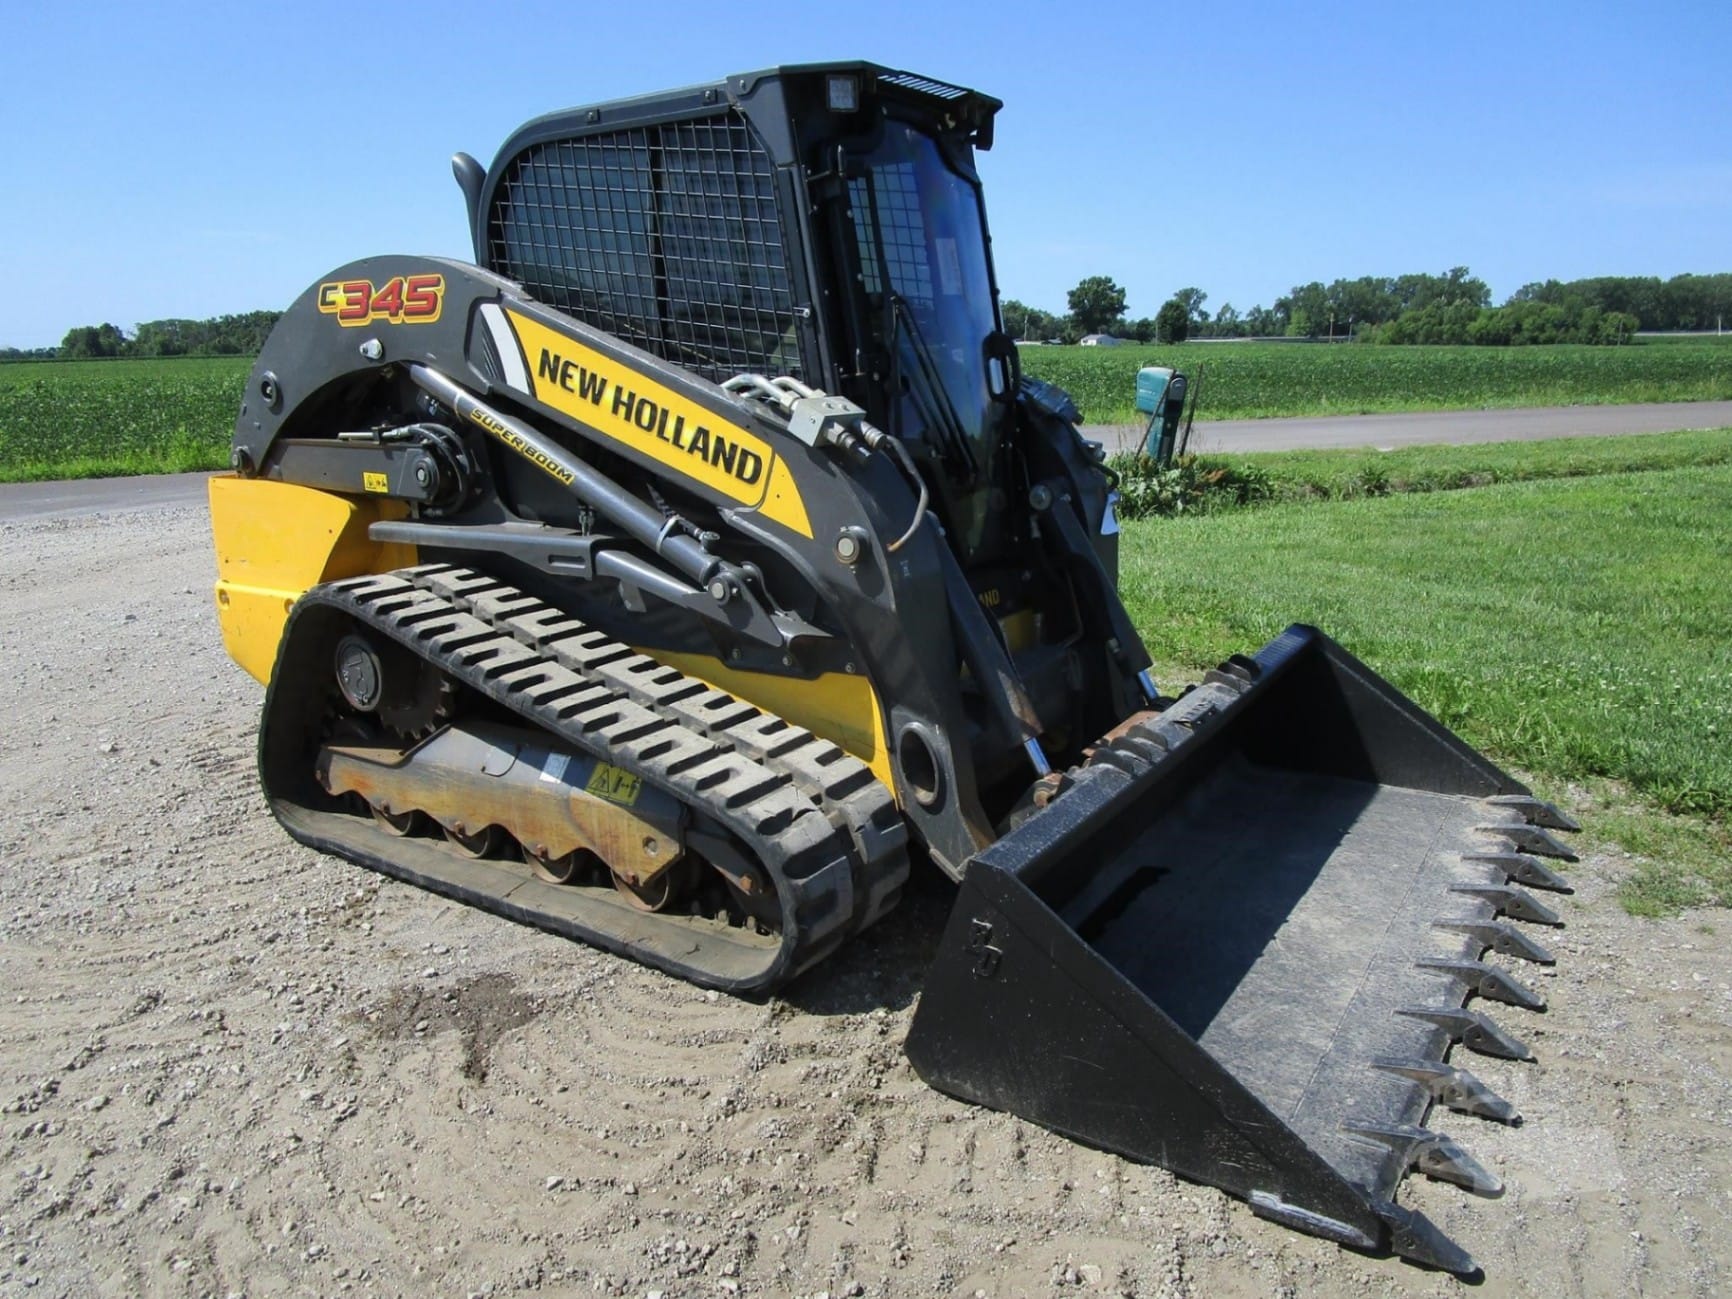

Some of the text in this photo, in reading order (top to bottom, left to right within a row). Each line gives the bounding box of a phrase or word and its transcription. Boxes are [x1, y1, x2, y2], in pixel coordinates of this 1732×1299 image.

[318, 274, 444, 325] C345
[471, 408, 574, 484] SUPER BOOM
[538, 347, 763, 486] NEW HOLLAND
